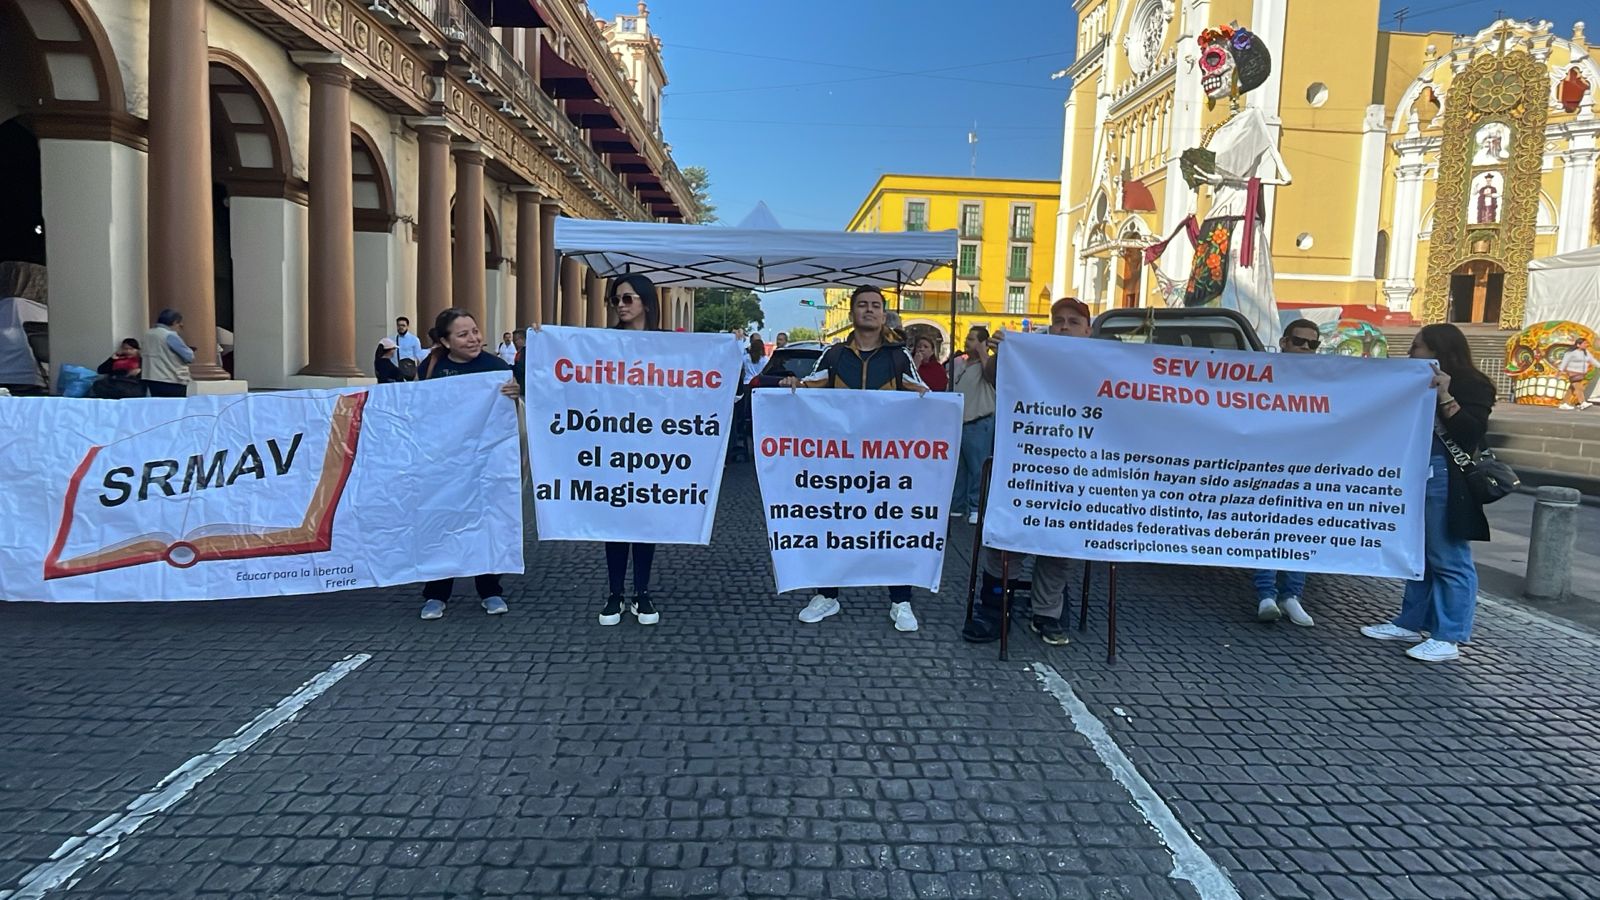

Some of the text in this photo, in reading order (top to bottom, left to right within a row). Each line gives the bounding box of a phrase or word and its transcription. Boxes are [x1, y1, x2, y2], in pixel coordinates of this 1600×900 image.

[554, 358, 721, 388] Cuitláhuac
[1153, 357, 1272, 382] SEV VIOLA
[1097, 380, 1329, 413] ACUERDO USICAMM
[549, 409, 719, 435] ¿Dónde está
[1013, 400, 1102, 419] Artículo 36
[1012, 420, 1093, 438] Párrafo IV
[577, 445, 691, 474] el apoyo
[761, 437, 948, 459] OFICIAL MAYOR
[99, 432, 303, 507] SRMAV
[1090, 450, 1097, 459] a
[1101, 448, 1119, 460] las
[1123, 453, 1189, 466] personas
[1193, 458, 1284, 472] participantes
[1287, 464, 1311, 475] que
[1314, 463, 1373, 476] derivado
[1377, 466, 1400, 478] del
[536, 479, 561, 500] al
[795, 469, 911, 493] despoja a
[1012, 462, 1402, 496] proceso de admisión hayan sido asignadas a una vacante
[1007, 477, 1405, 514] definitiva y cuenten ya con otra plaza definitiva en un nivel
[770, 501, 937, 519] maestro de su
[1013, 498, 1395, 531] o servicio educativo distinto, las autoridades educativas
[769, 531, 818, 551] laza
[1023, 514, 1381, 547] de las entidades federativas deberán preveer que las
[1084, 538, 1187, 553] readscripciones
[1191, 545, 1222, 555] sean
[236, 564, 353, 581] Educar para la libertad
[325, 577, 356, 587] Freire
